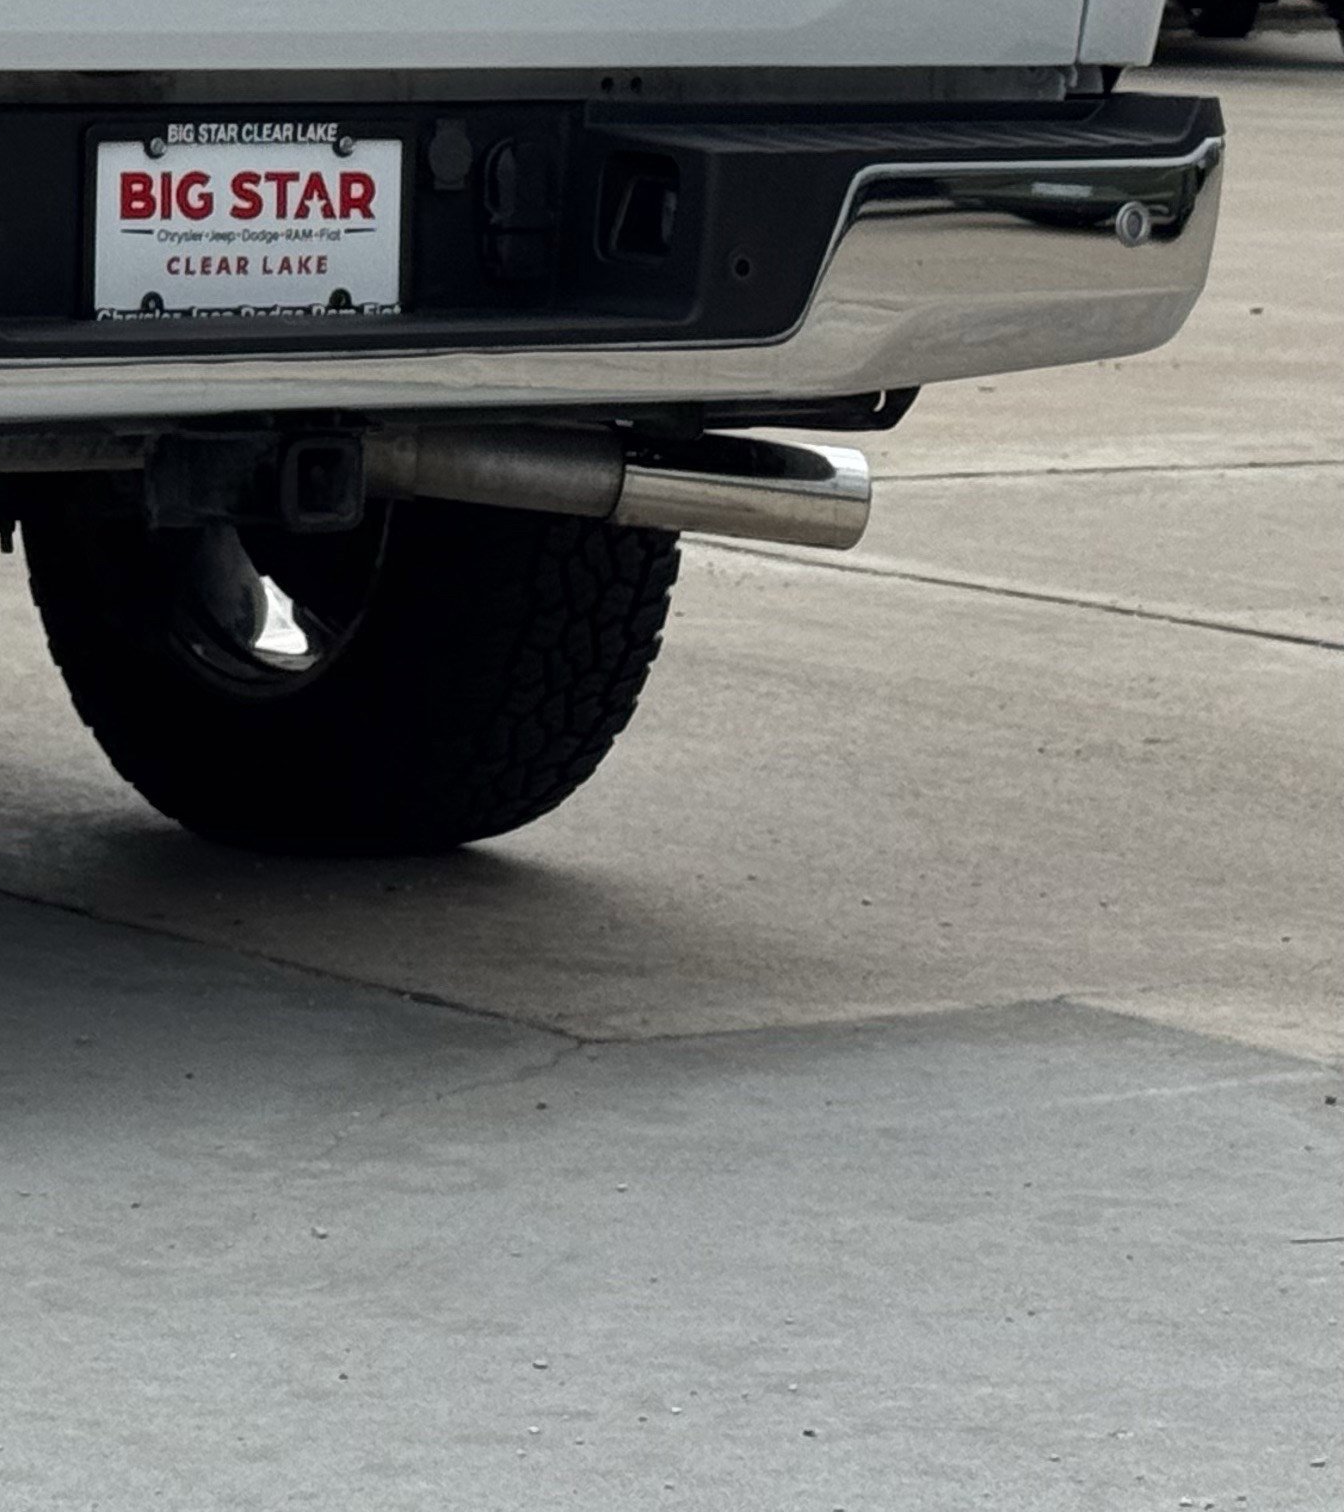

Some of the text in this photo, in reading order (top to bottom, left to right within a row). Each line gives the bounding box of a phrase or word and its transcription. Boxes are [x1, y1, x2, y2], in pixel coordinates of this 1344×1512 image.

[167, 122, 339, 143] BIG STAR CLEAR LAKE
[120, 171, 376, 220] BIG STAR
[319, 228, 342, 241] Fiat
[166, 255, 329, 276] CLEAR LAKE
